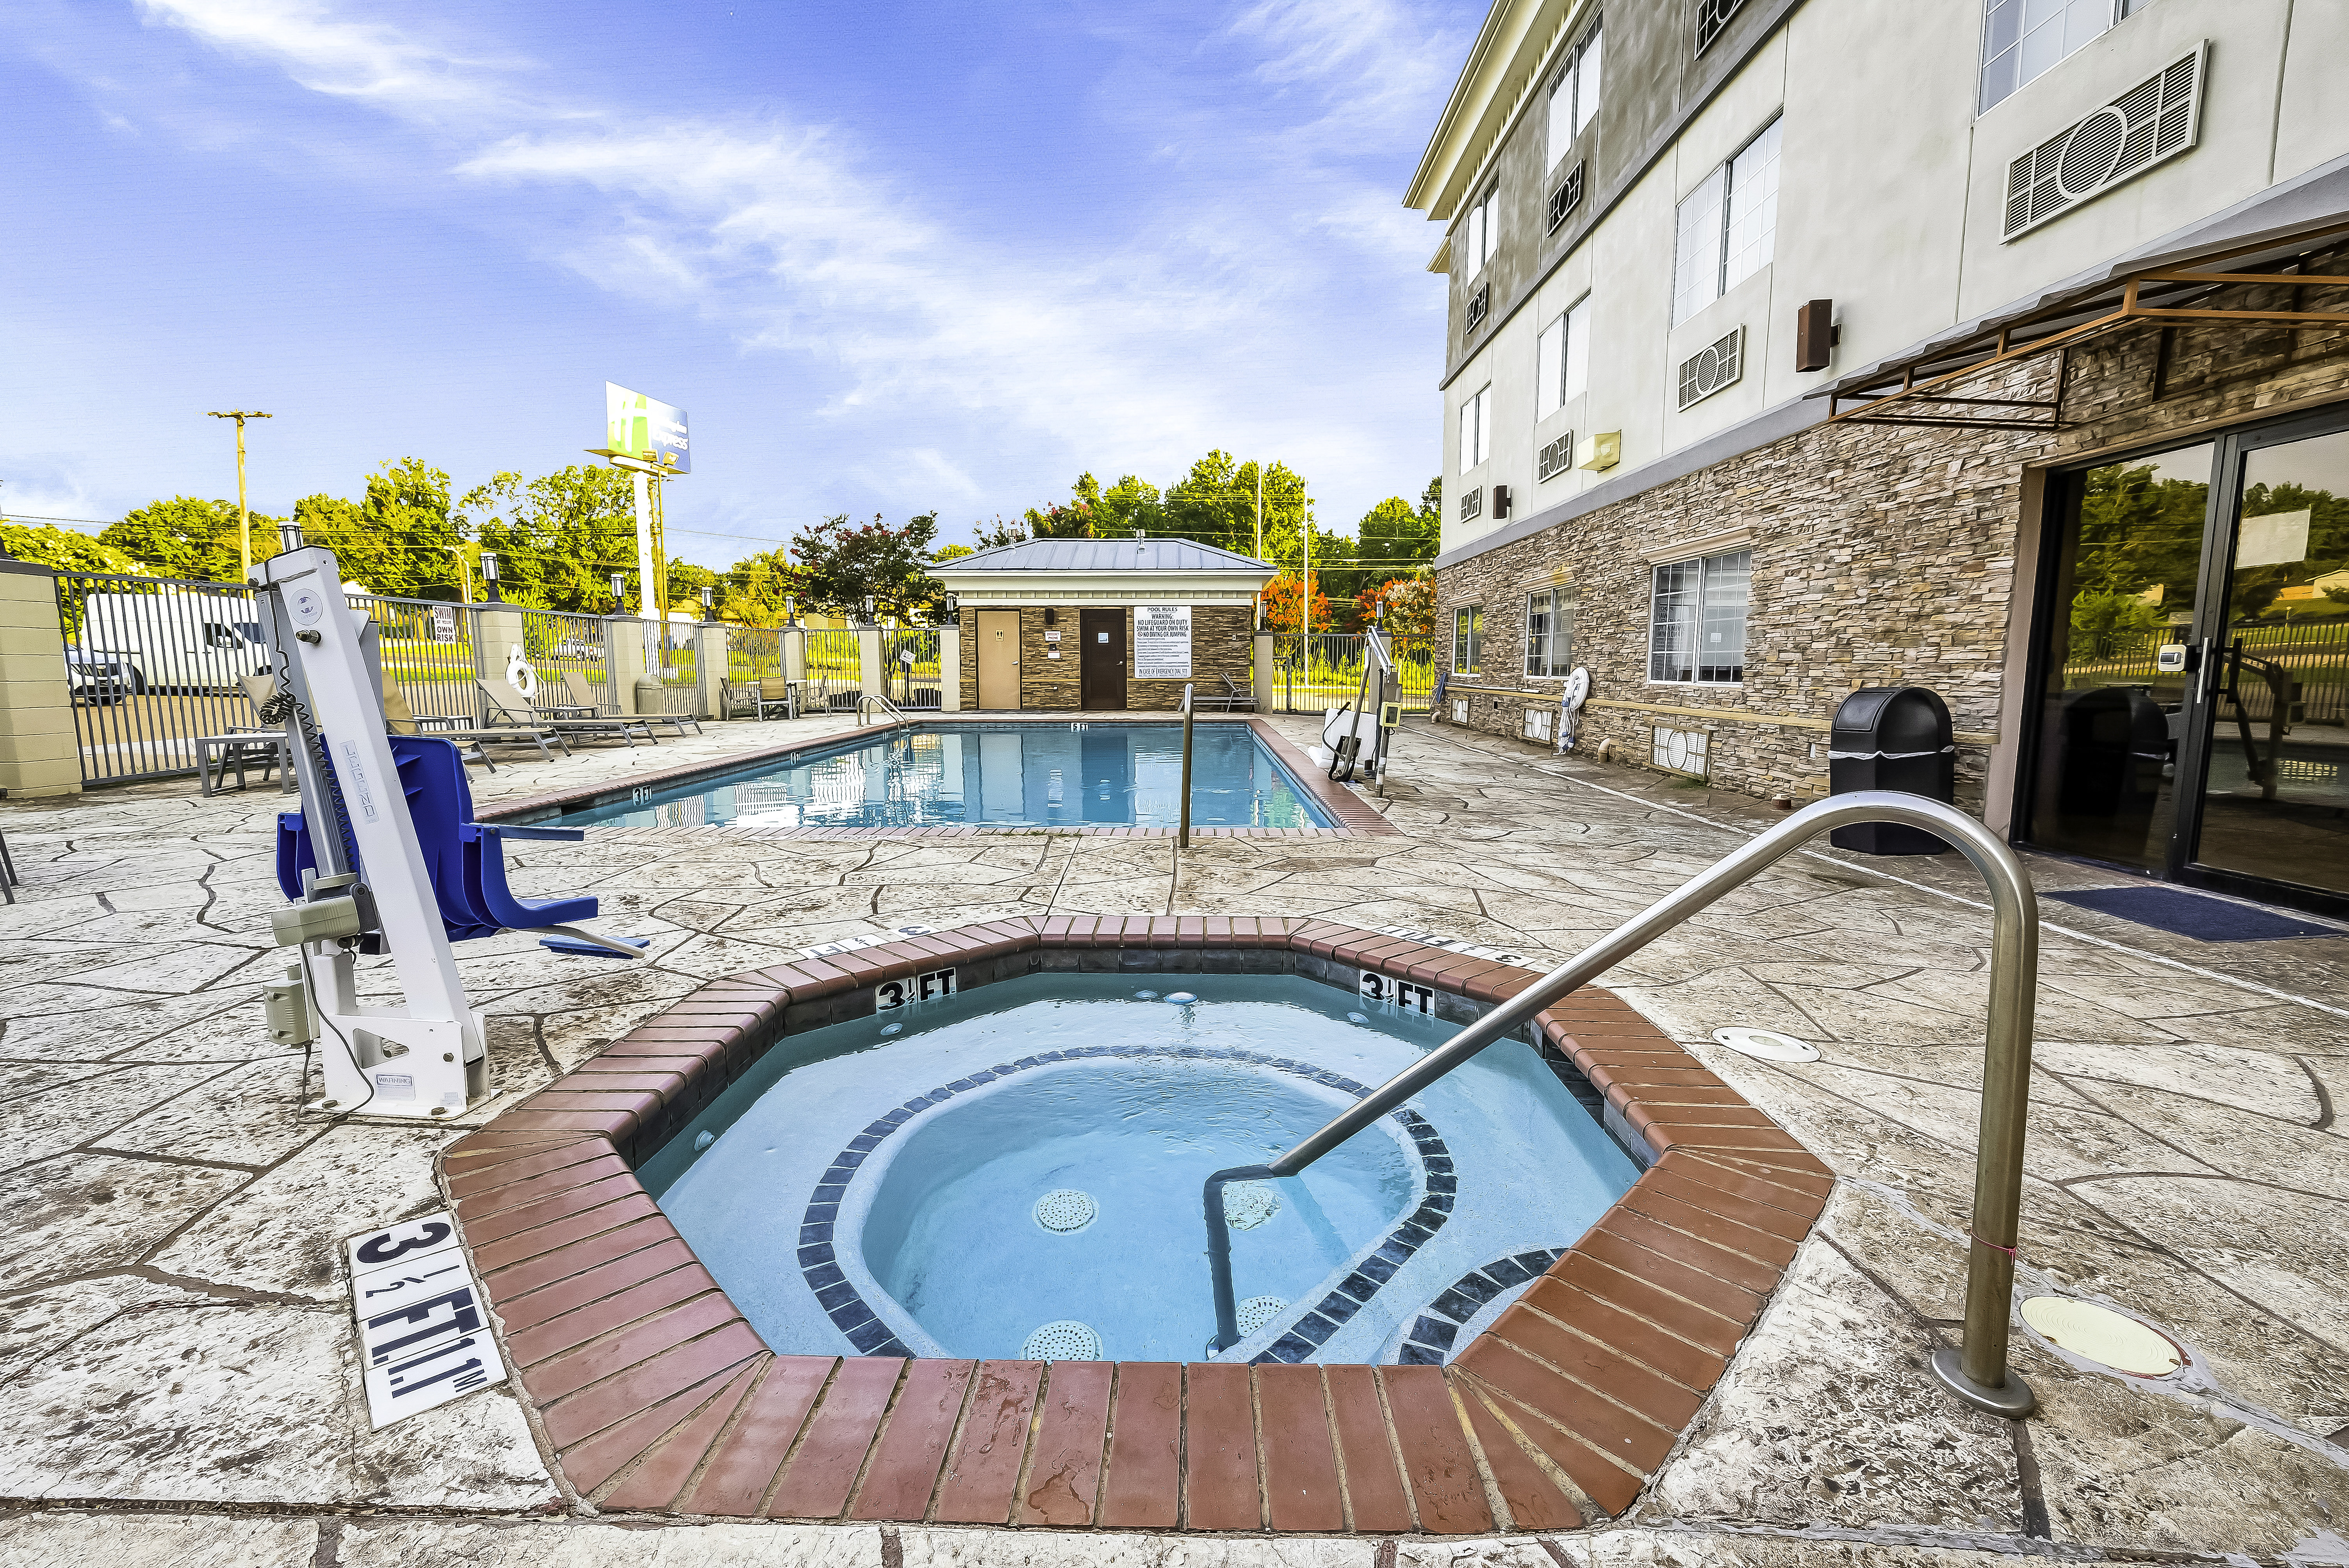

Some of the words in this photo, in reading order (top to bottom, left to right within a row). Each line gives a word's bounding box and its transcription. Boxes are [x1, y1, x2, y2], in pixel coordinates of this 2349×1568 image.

[434, 607, 452, 620] SWIM
[634, 788, 641, 805] 3
[898, 926, 930, 935] 3
[1495, 954, 1522, 964] 3
[1361, 973, 1385, 1000] 3
[878, 982, 906, 1010] 3
[357, 1222, 451, 1263] 3
